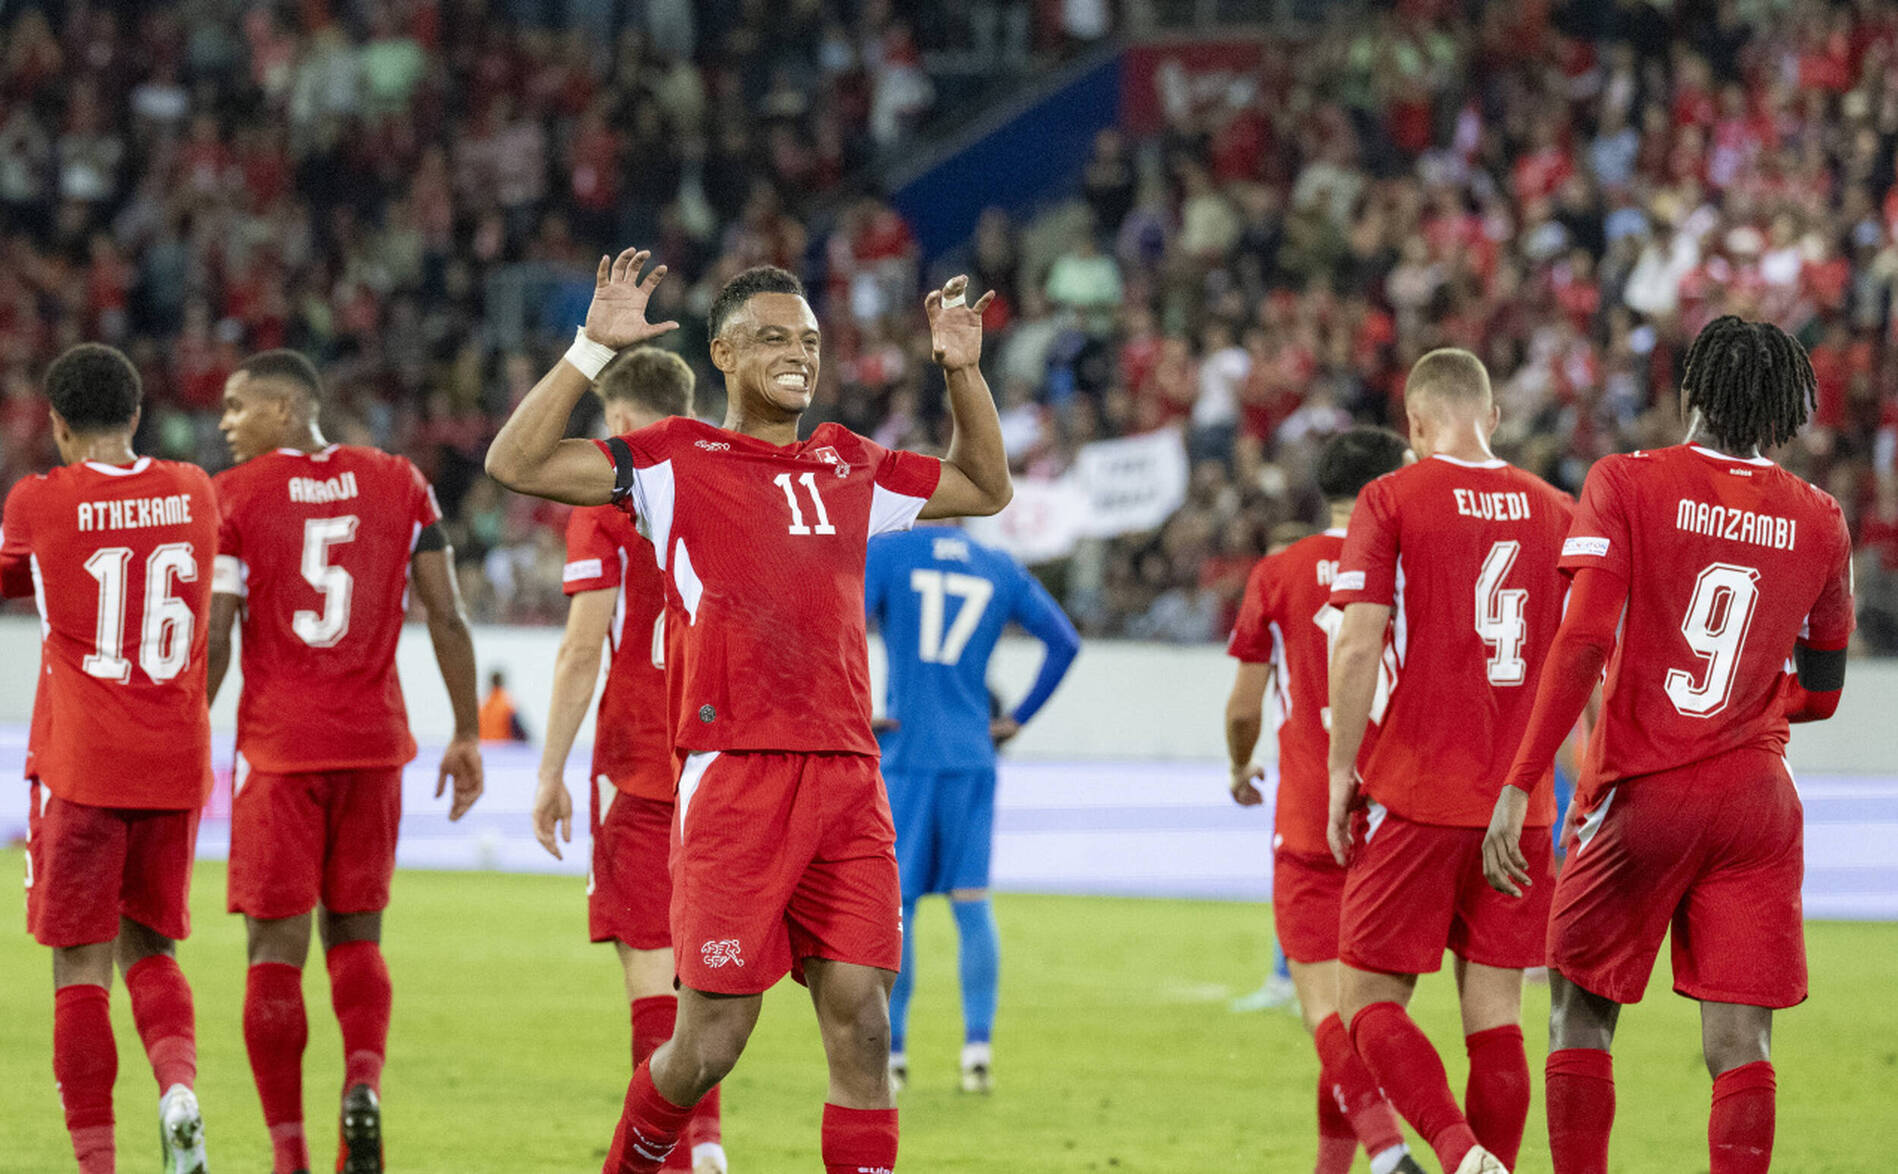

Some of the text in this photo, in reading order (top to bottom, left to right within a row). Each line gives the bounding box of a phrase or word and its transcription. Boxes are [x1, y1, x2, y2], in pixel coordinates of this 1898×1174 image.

[78, 493, 193, 532] ATHEKAME
[773, 472, 837, 536] 11
[1453, 488, 1531, 521] ELVEDI
[1676, 498, 1797, 551] MANZAMBI
[82, 541, 199, 686] 16
[292, 514, 360, 648] 5
[910, 568, 994, 666] 17
[1474, 539, 1529, 687] 4
[1664, 561, 1762, 719] 9
